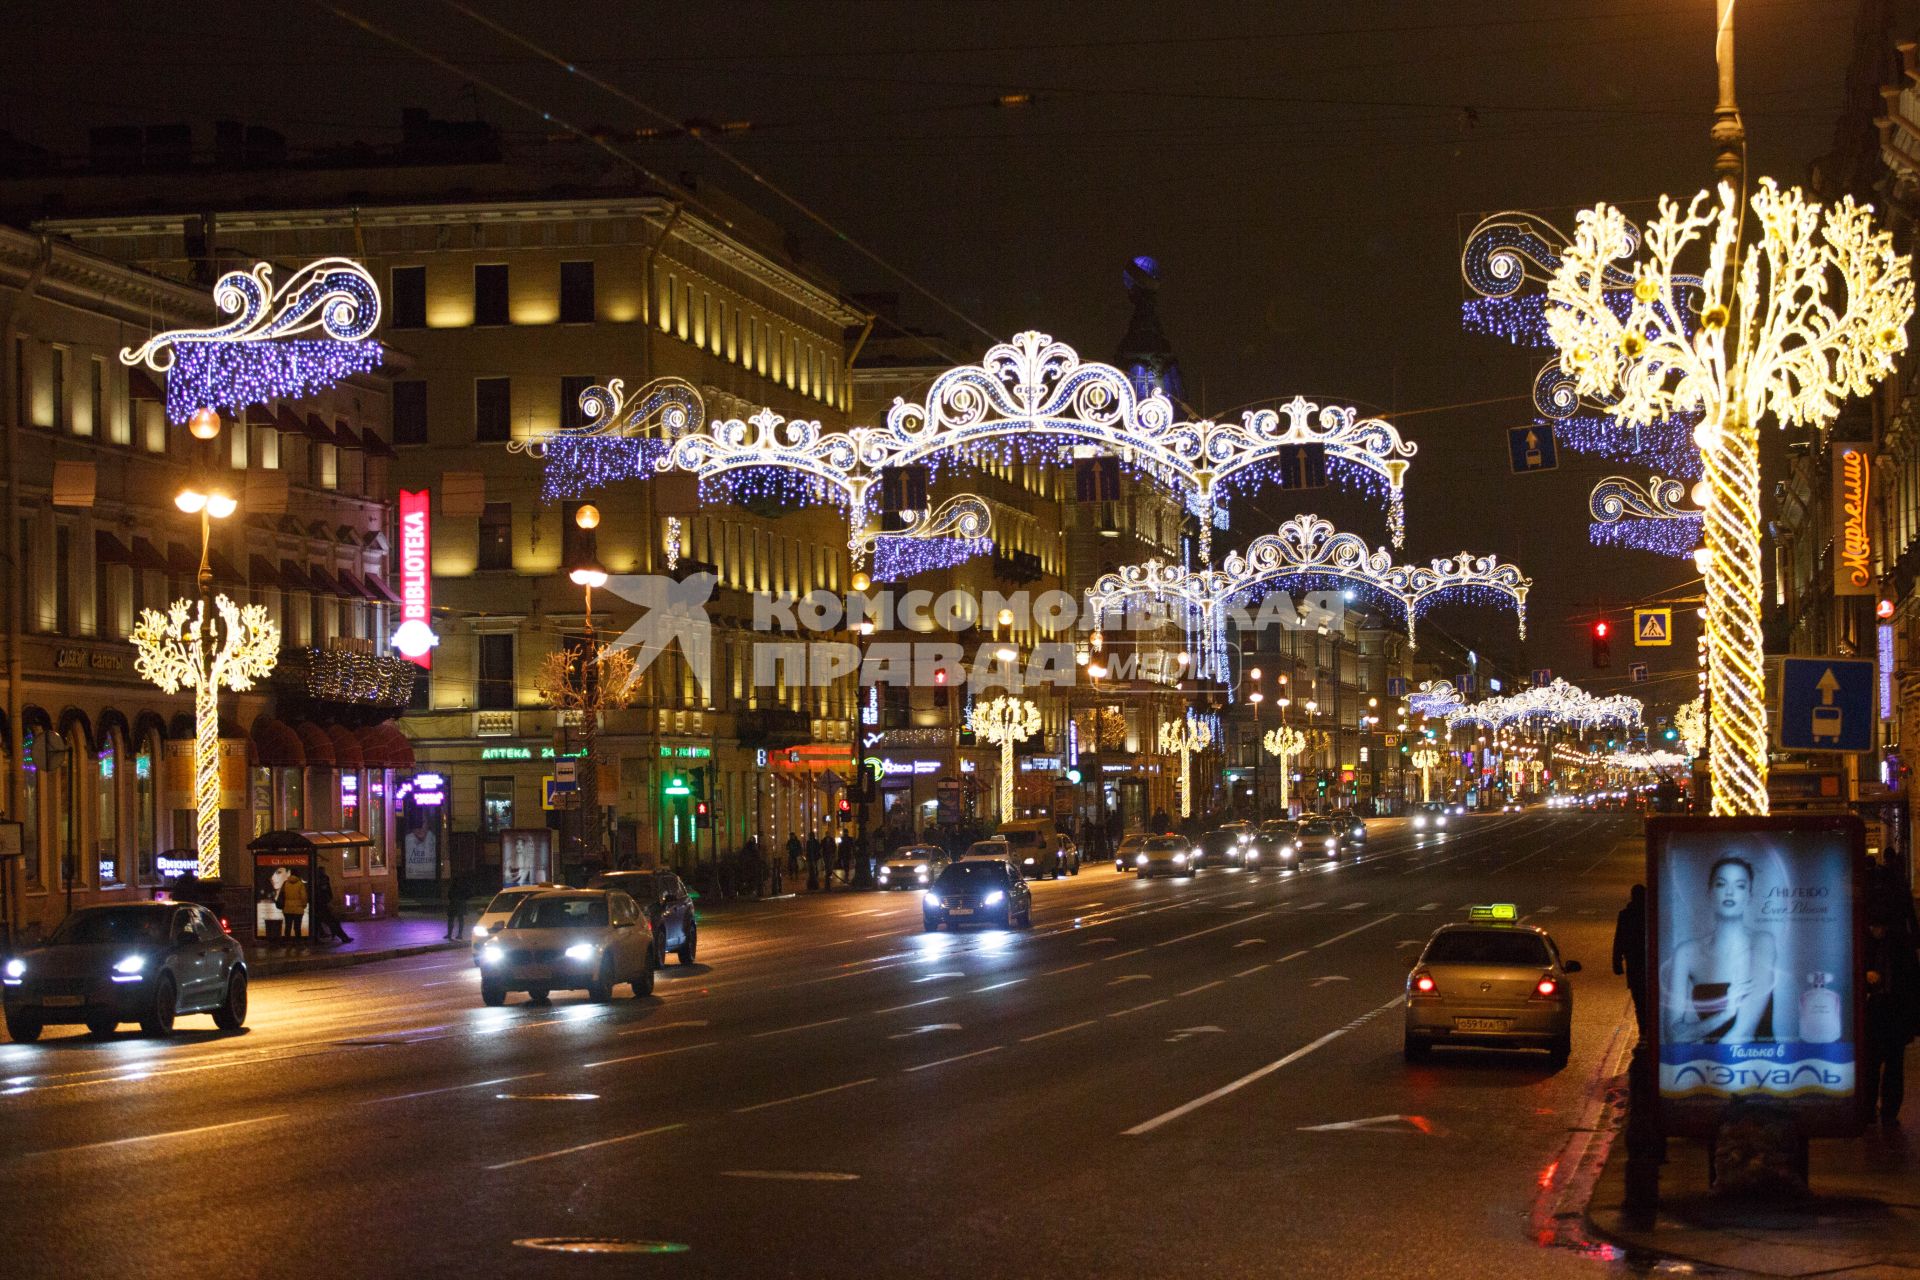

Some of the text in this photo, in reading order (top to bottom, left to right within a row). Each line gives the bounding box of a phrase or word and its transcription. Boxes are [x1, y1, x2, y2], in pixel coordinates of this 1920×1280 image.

[404, 511, 426, 618] BIBLIOTEKA
[481, 748, 532, 759] АПТЕКА
[541, 748, 555, 758] 24
[1764, 886, 1829, 899] SHISEIDO
[1729, 1044, 1775, 1058] Только
